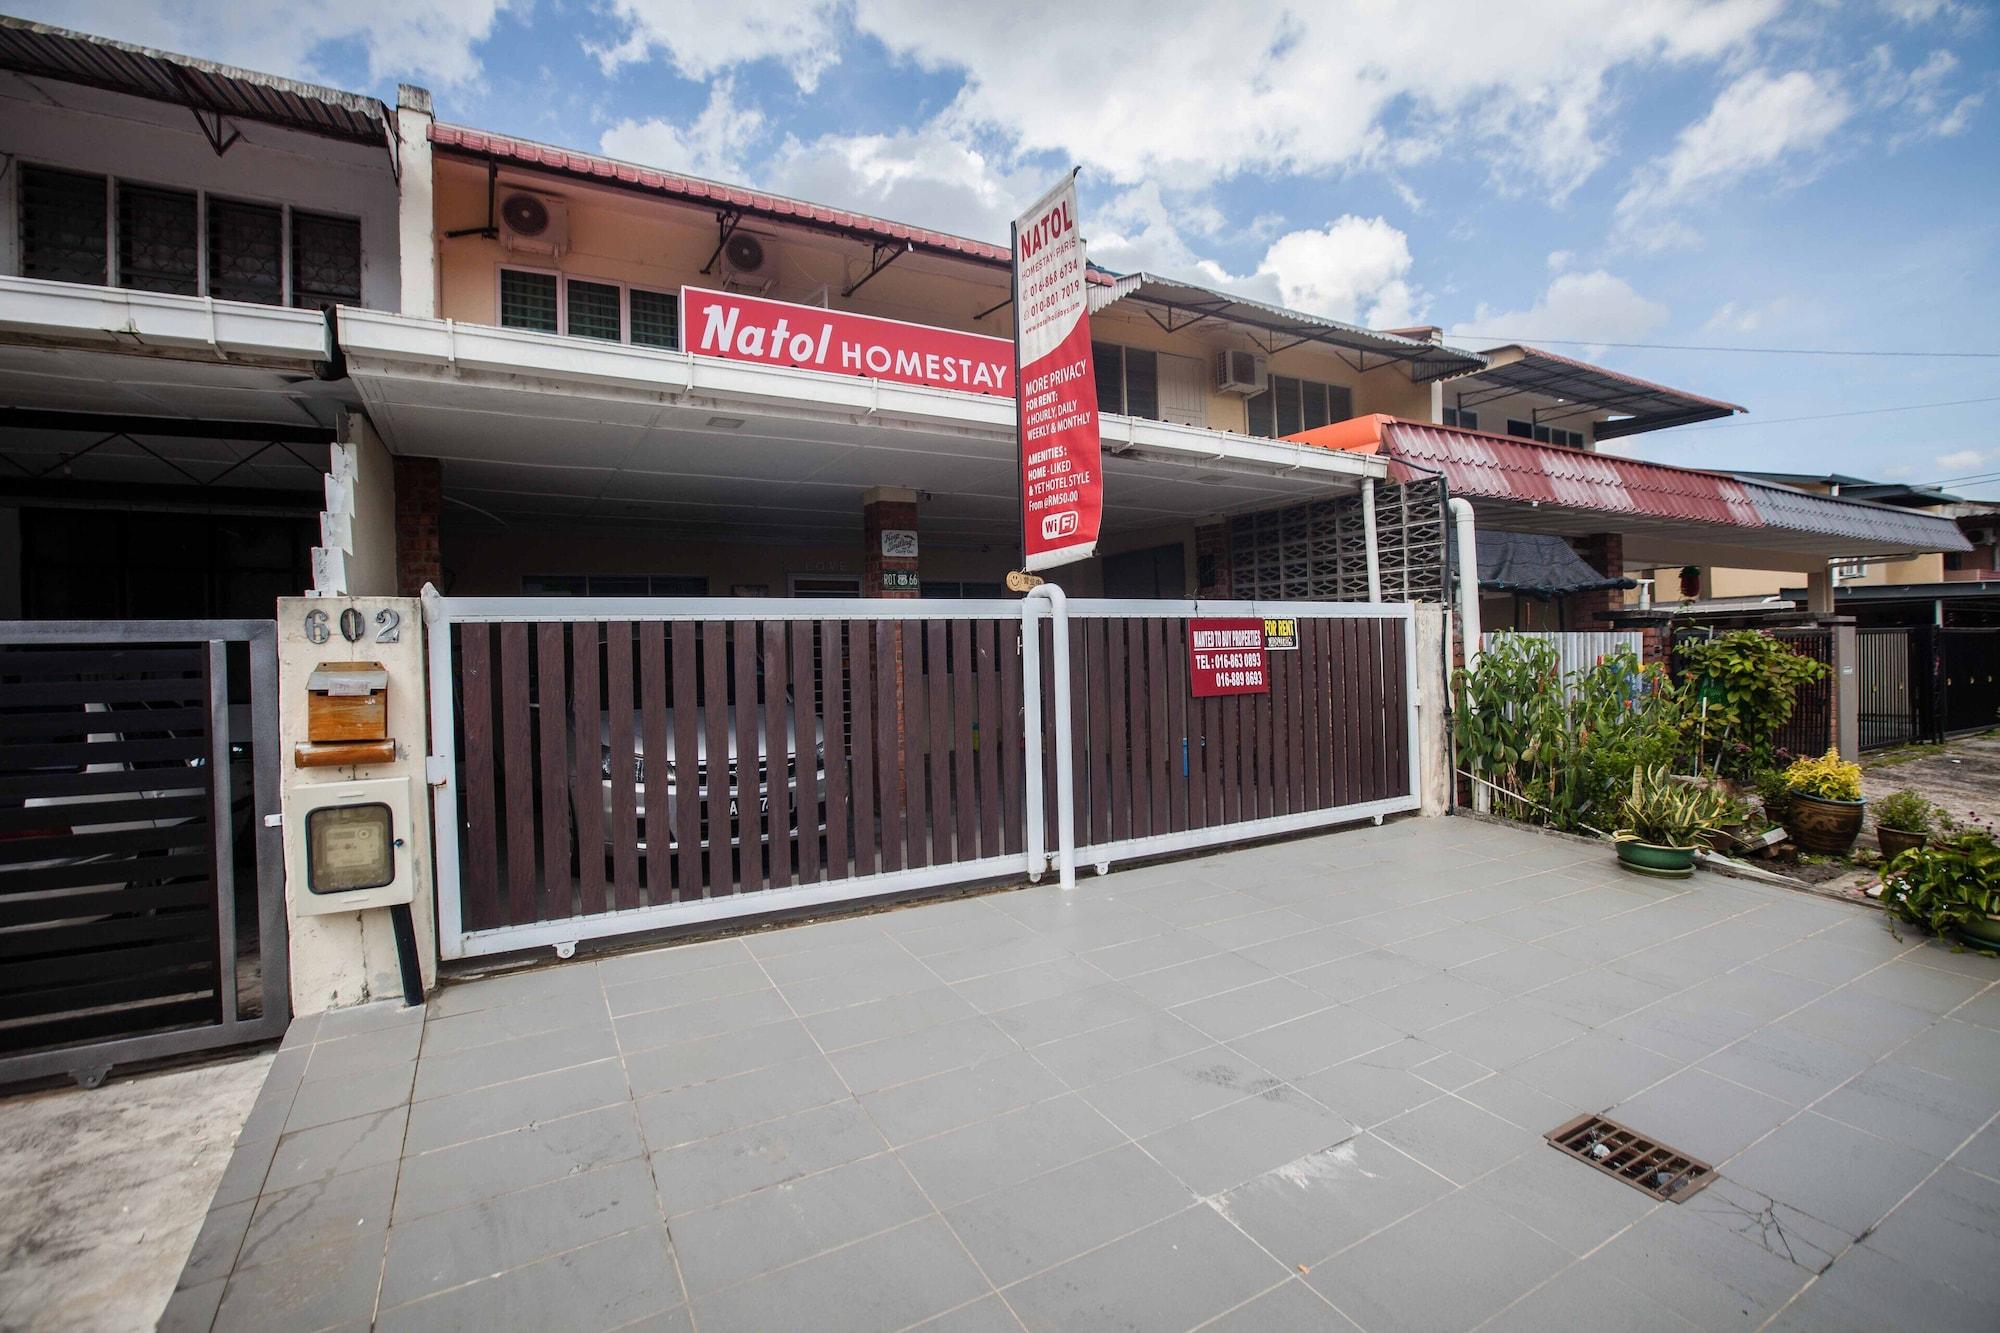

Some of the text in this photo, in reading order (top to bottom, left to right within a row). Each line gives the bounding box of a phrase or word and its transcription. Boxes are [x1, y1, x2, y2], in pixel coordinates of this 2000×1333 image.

[1020, 200, 1073, 262] NATOL
[1030, 258, 1078, 297] 016-868 6734
[1031, 279, 1080, 317] 010-801 7019
[700, 303, 1008, 389] Natol HOMESTAY
[1025, 359, 1087, 397] MORE PRIVACY
[1026, 390, 1058, 412] FOR RENT:
[1027, 415, 1031, 426] 4
[1058, 400, 1077, 416] DAILY
[1027, 411, 1091, 441] WEEKLY & MONTHLY
[1028, 471, 1090, 497] & YET HOTEL STYLE
[1029, 500, 1044, 512] From
[304, 607, 400, 644] 602
[1193, 630, 1214, 648] WANTED
[1214, 630, 1221, 647] TO
[1232, 629, 1261, 647] PROPERTIES
[1264, 619, 1294, 637] FOR RENT
[1215, 653, 1243, 669] 016-863
[1216, 671, 1244, 687] 016-889
